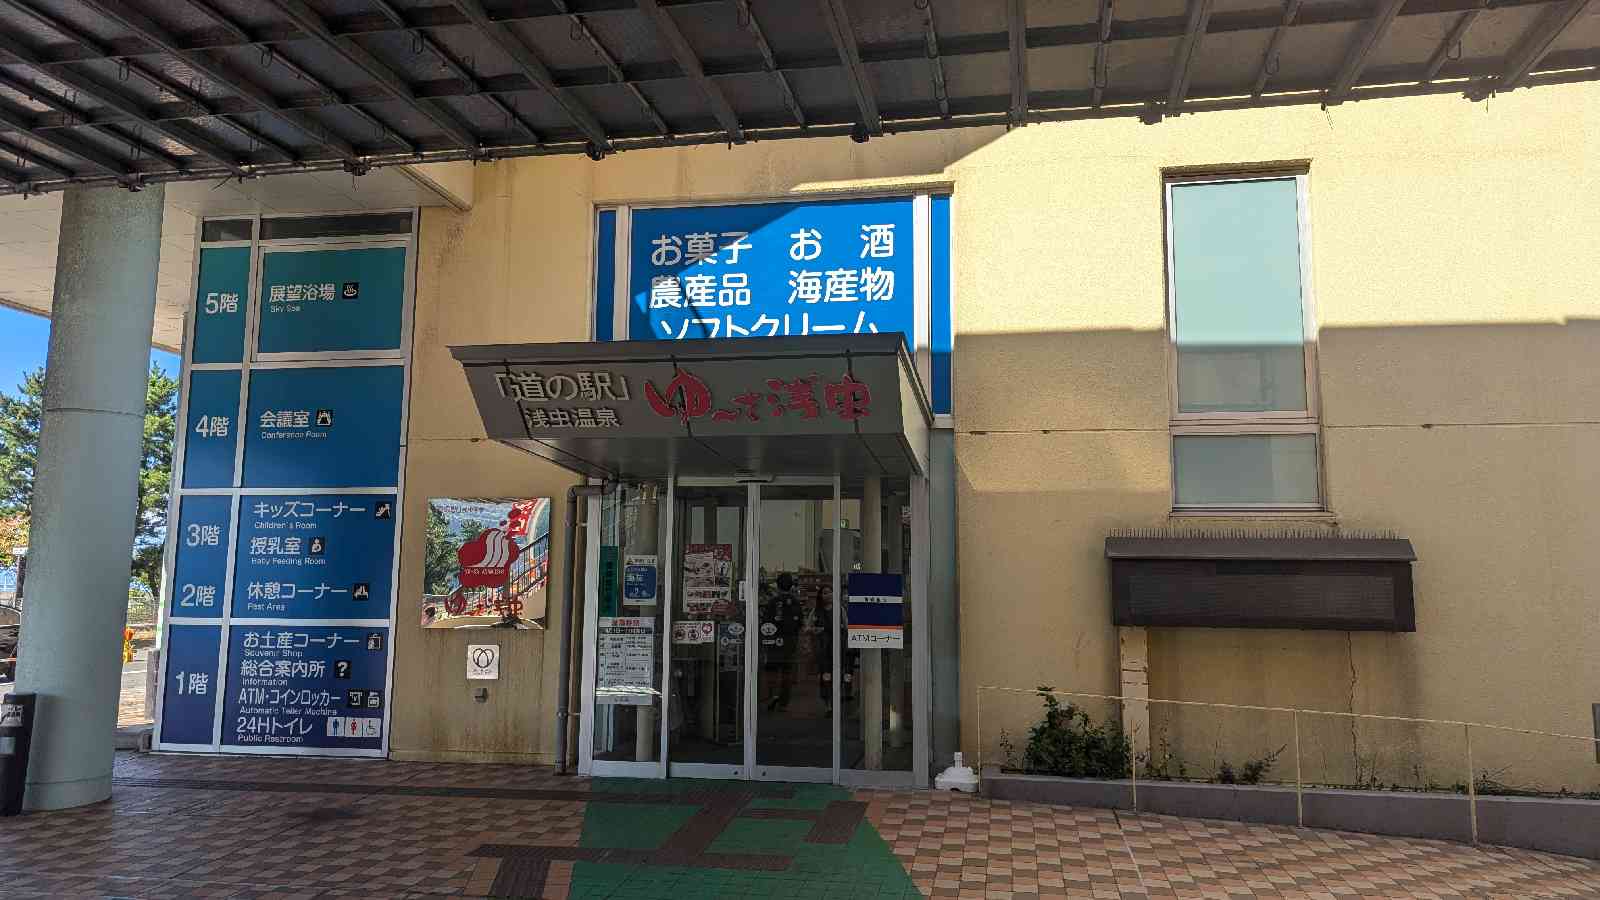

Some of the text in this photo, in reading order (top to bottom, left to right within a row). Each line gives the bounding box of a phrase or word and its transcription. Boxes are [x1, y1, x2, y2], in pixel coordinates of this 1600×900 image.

[651, 231, 753, 266] お菓子
[269, 283, 336, 303] 展望浴場
[649, 266, 895, 309] 農産品 海産物
[205, 293, 239, 314] 5階
[660, 311, 880, 340] ソフトクリーム
[494, 372, 630, 401] 「道の駅」
[195, 415, 230, 438] 4階
[260, 410, 310, 428] 会議室
[524, 408, 622, 428] 浅虫温泉
[261, 431, 304, 439] Conference
[254, 501, 366, 518] キッズコーナー
[186, 524, 221, 547] 3階
[250, 536, 301, 555] 授乳室
[251, 558, 270, 566] Baby
[272, 558, 302, 567] Feeding
[180, 584, 216, 608] 2階
[247, 581, 348, 600] 休憩コーナー
[266, 603, 286, 611] Area
[243, 631, 360, 649] お土産コーナー
[851, 633, 902, 643] ATMコーナー
[282, 650, 303, 659] Shop
[240, 659, 326, 678] 総合案内所
[176, 672, 209, 695] 1階
[239, 707, 279, 715] Automatic
[305, 708, 337, 716] Machine
[235, 716, 313, 735] 24Hトイレ
[238, 735, 303, 744] Public Restroom
